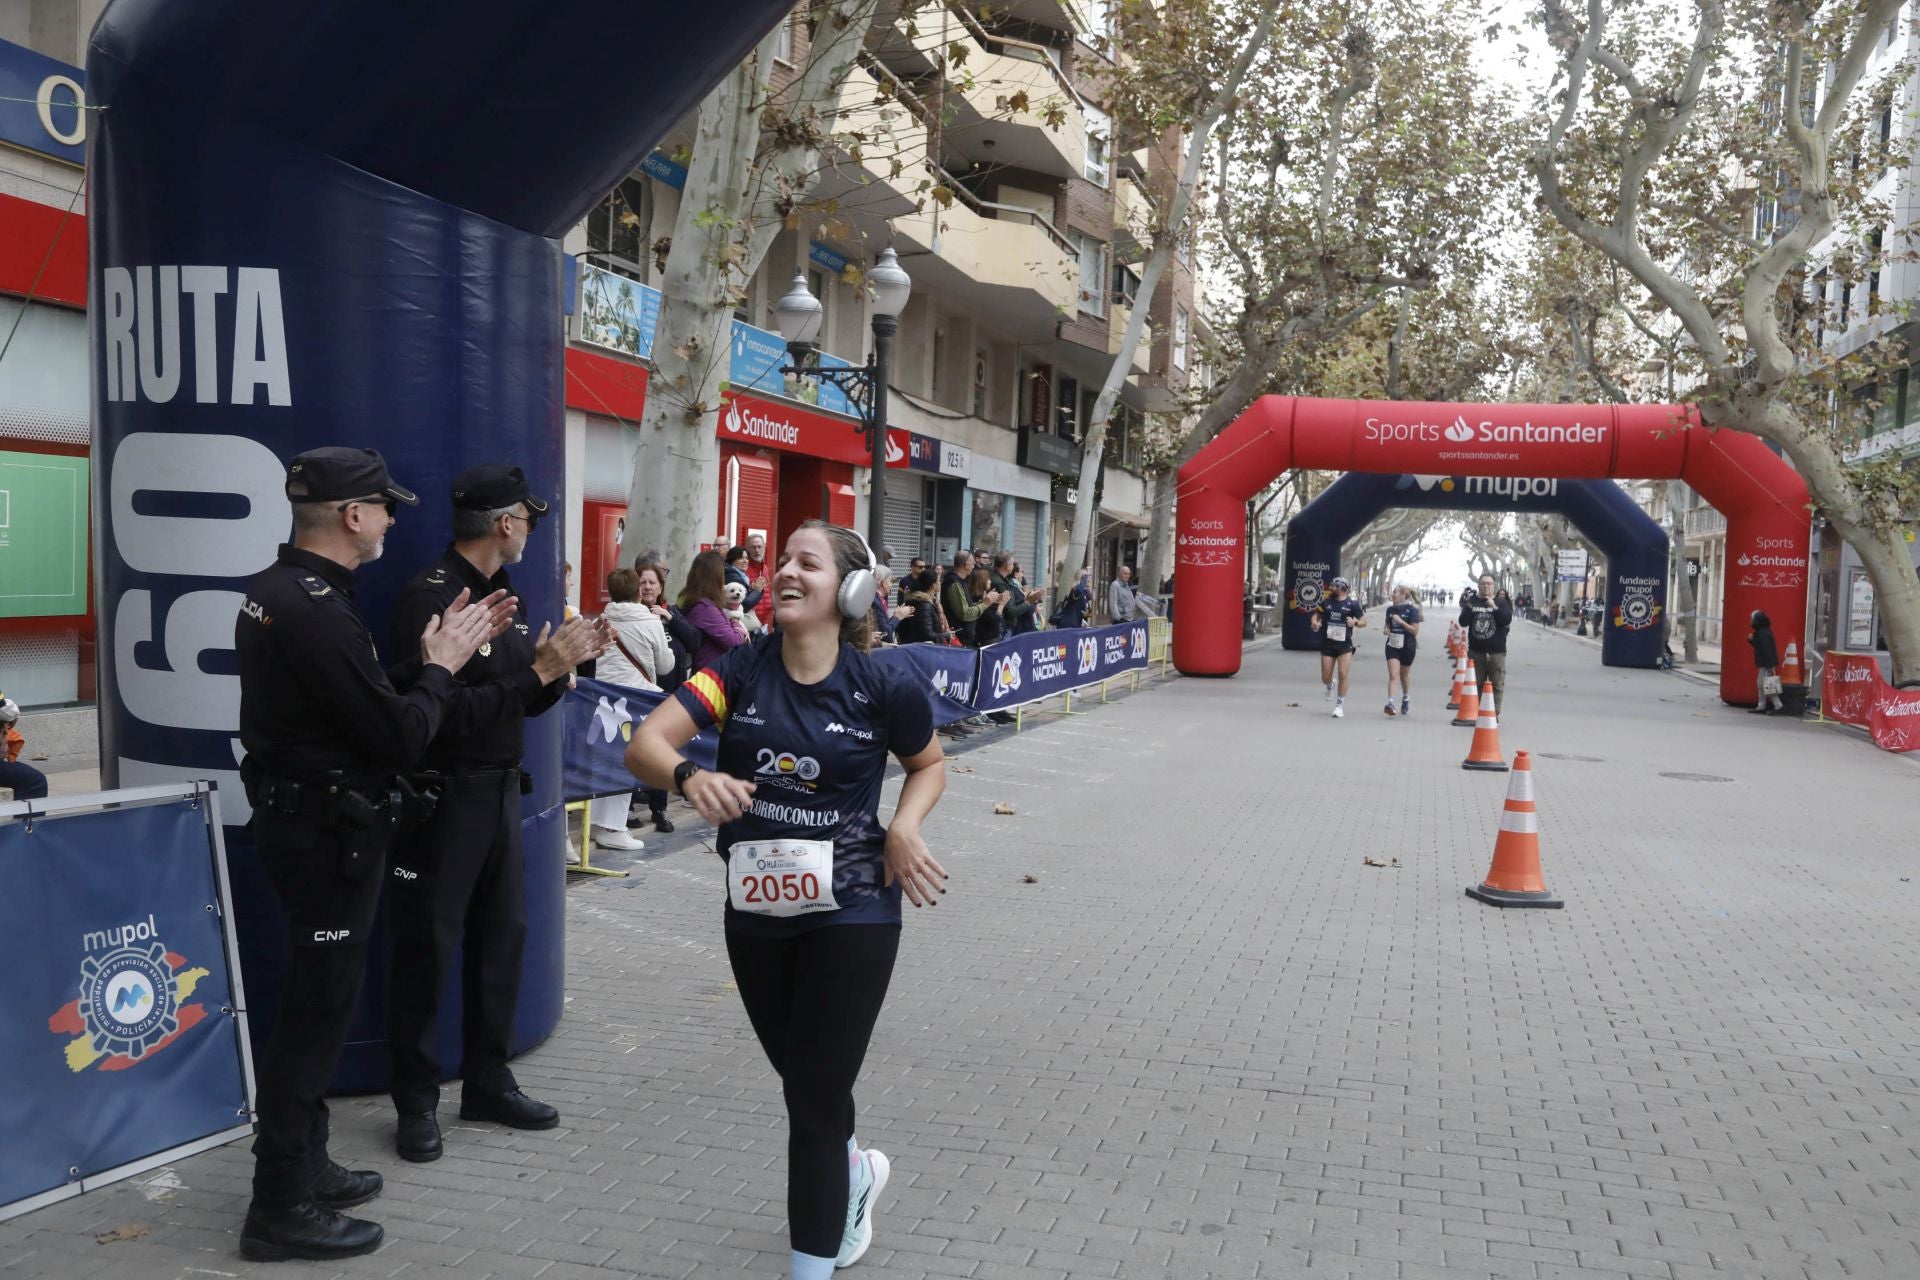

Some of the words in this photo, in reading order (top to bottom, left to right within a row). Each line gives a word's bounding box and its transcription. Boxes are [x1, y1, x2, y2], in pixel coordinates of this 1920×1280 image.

[104, 265, 292, 407] RUTA
[742, 408, 799, 445] Santander
[1365, 418, 1440, 445] Sports
[1478, 421, 1607, 443] Santander
[1439, 451, 1519, 460] sportssantander.es
[1465, 476, 1557, 501] mupol
[1191, 518, 1224, 530] Sports
[1188, 536, 1237, 546] Santander
[1756, 537, 1794, 549] Sports
[1293, 561, 1330, 571] fundación
[1752, 555, 1806, 567] Santander
[1298, 571, 1322, 579] mupol
[1619, 576, 1660, 586] fundación
[1625, 585, 1652, 594] mupol
[1131, 628, 1147, 659] 200
[1078, 636, 1098, 675] 200
[1033, 667, 1067, 682] NACIONAL
[732, 712, 766, 726] Santander
[847, 728, 873, 740] mupol
[755, 748, 821, 781] 200
[394, 867, 418, 880] CNP
[742, 873, 820, 903] 2050
[83, 914, 158, 952] mupol
[314, 930, 350, 941] CNP
[94, 979, 110, 1028] mutualidad
[112, 957, 149, 971] previsión
[149, 968, 164, 994] social
[115, 1019, 154, 1035] POLICÍA
